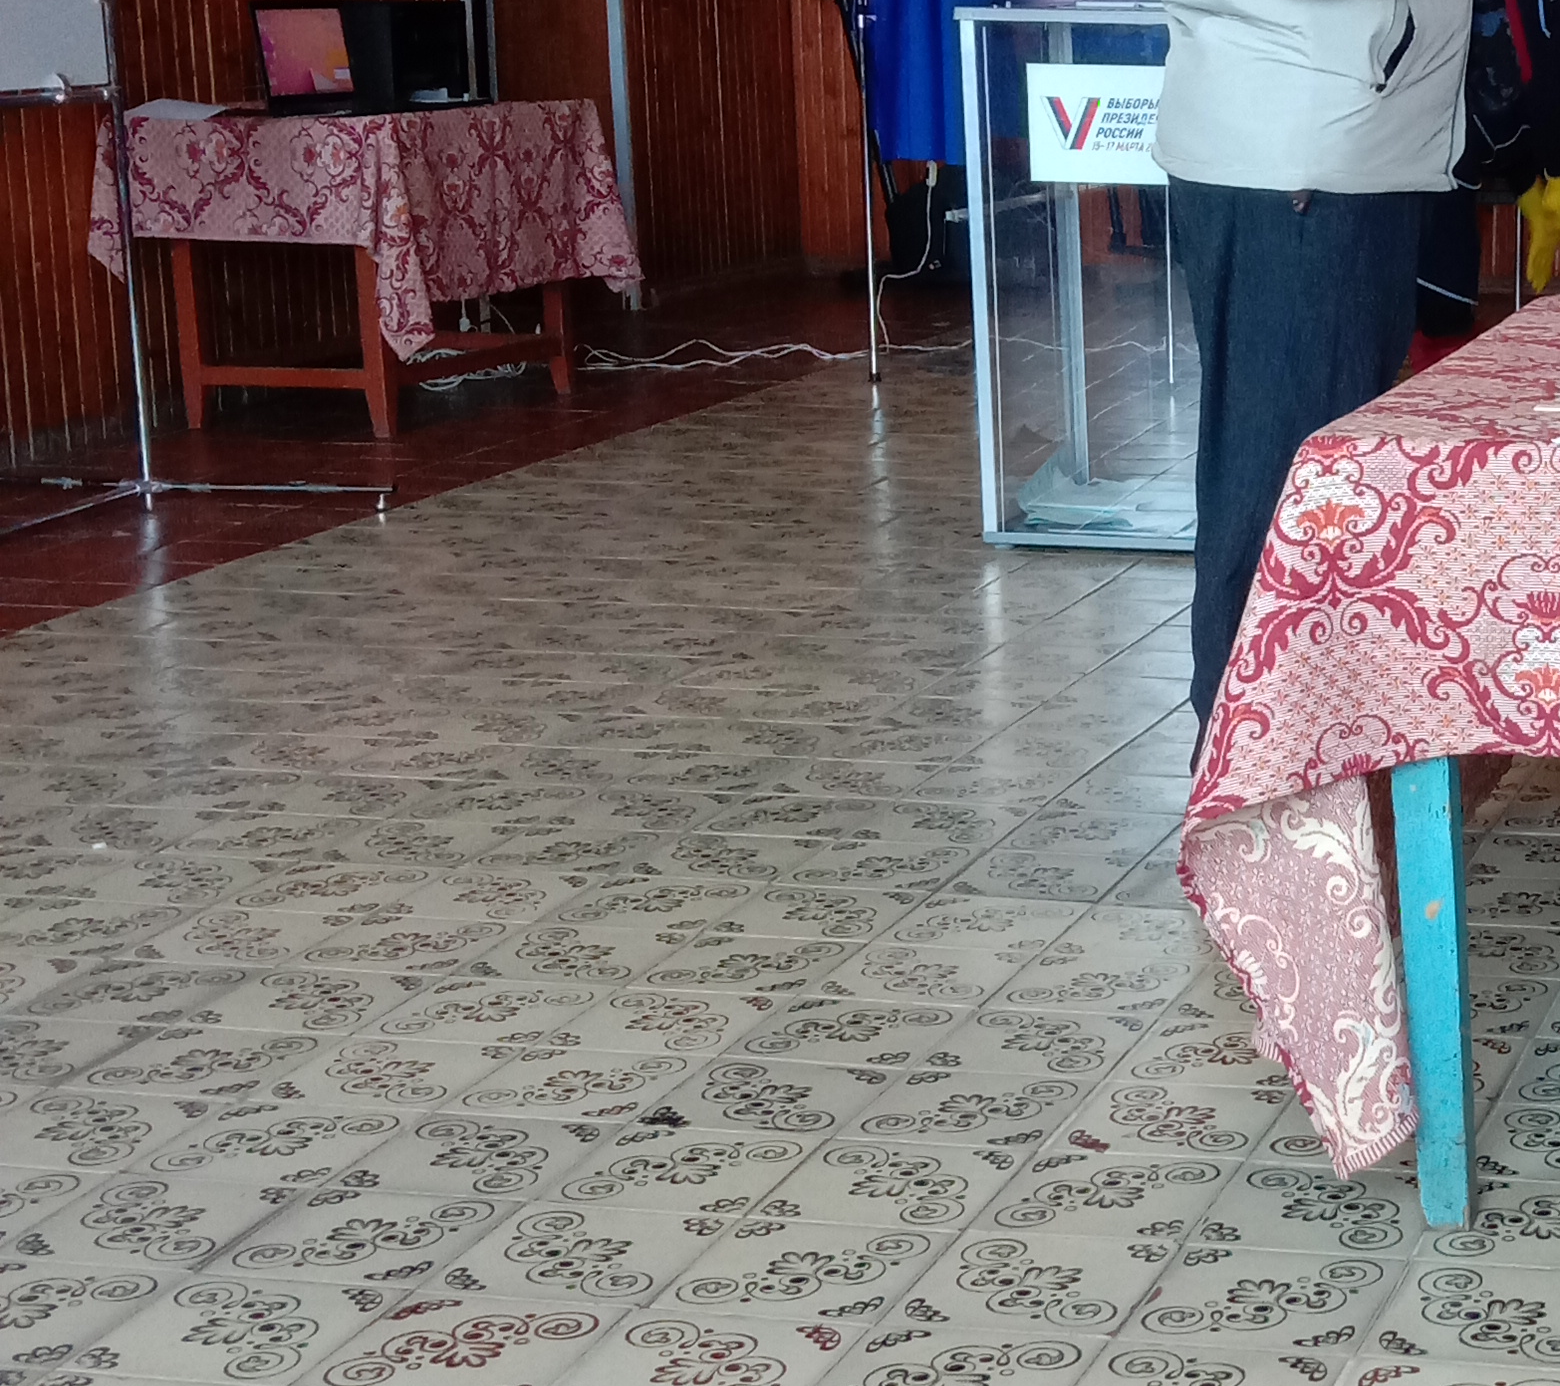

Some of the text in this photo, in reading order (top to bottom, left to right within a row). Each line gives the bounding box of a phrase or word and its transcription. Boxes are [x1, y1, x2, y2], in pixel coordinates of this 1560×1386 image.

[1107, 98, 1160, 110] ВЫБОРЫ
[1101, 112, 1159, 125] ПРЕЗИДЕ
[1096, 127, 1144, 139] РОССИИ
